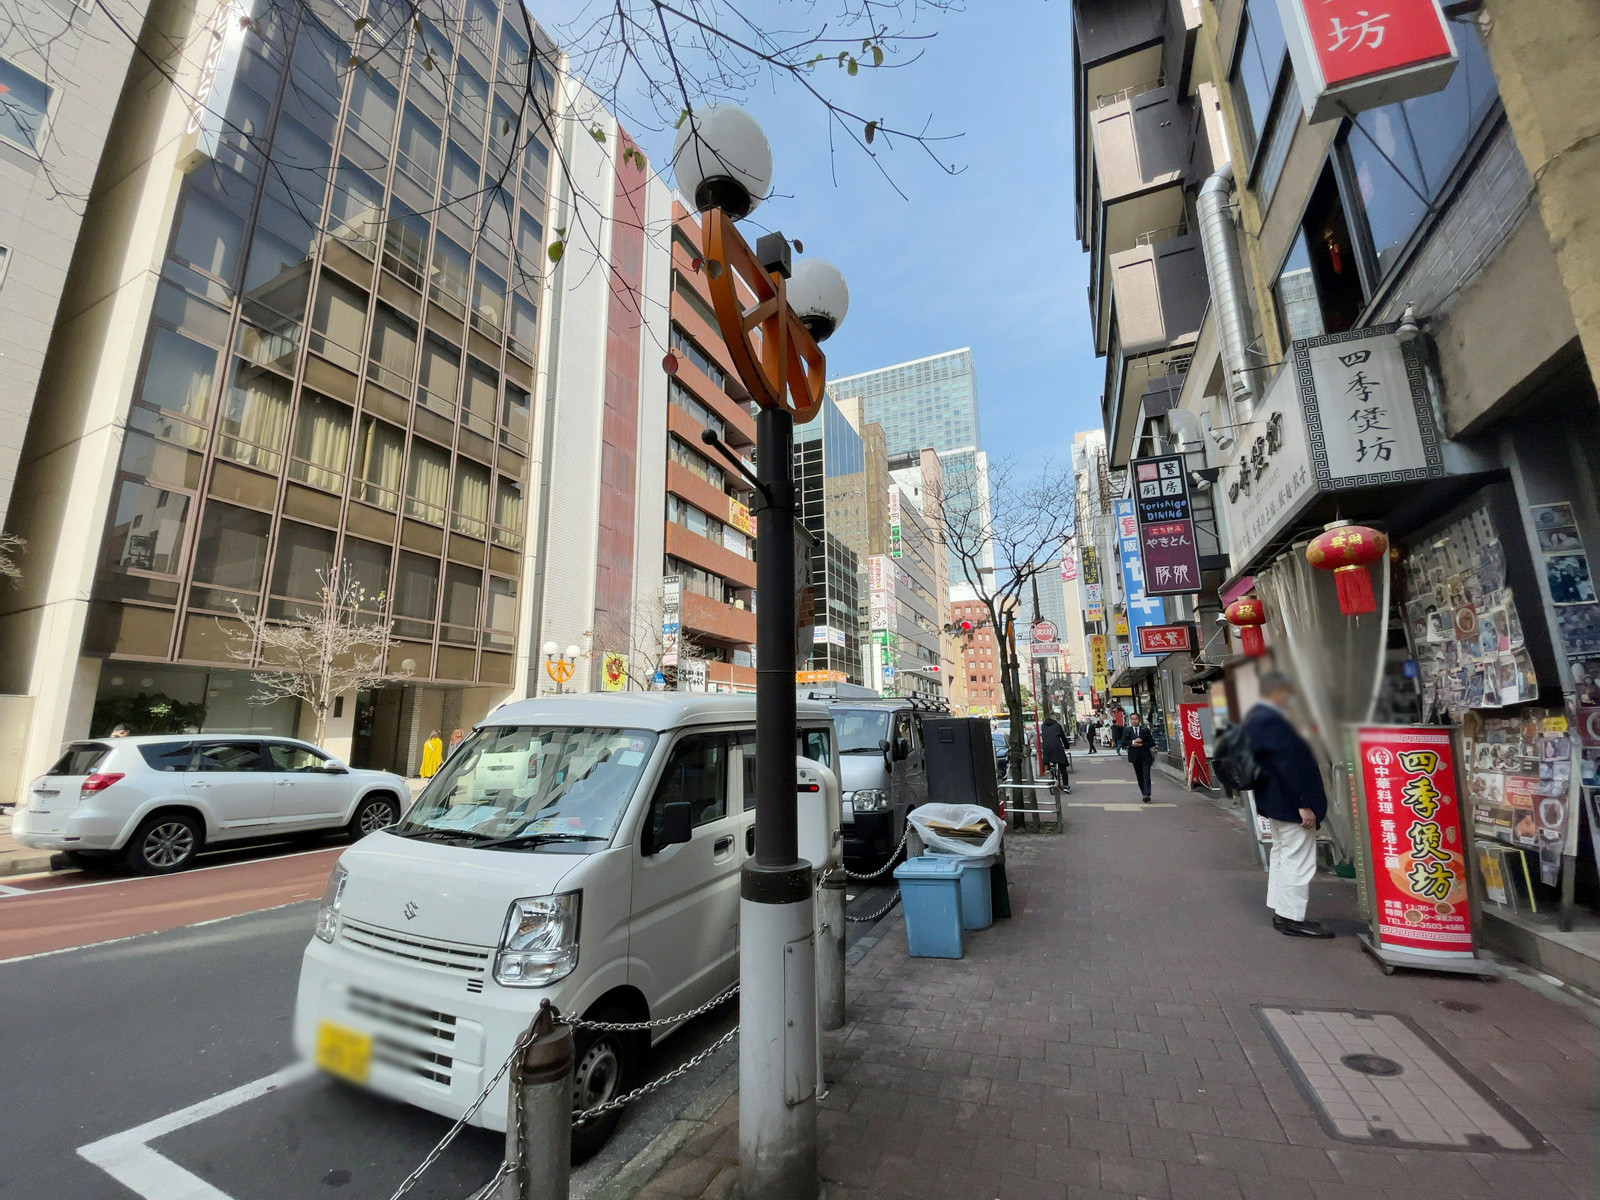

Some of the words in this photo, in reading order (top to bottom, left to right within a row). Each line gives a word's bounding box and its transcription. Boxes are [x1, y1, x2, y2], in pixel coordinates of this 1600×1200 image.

[1327, 11, 1391, 53] 坊
[1338, 349, 1396, 464] 四季煲坊
[1146, 510, 1183, 521] DINING
[1146, 537, 1190, 548] やきとん
[1374, 766, 1394, 814] 中華料理
[1380, 819, 1401, 870] 香港土鍋
[1397, 749, 1454, 902] 四季煲坊
